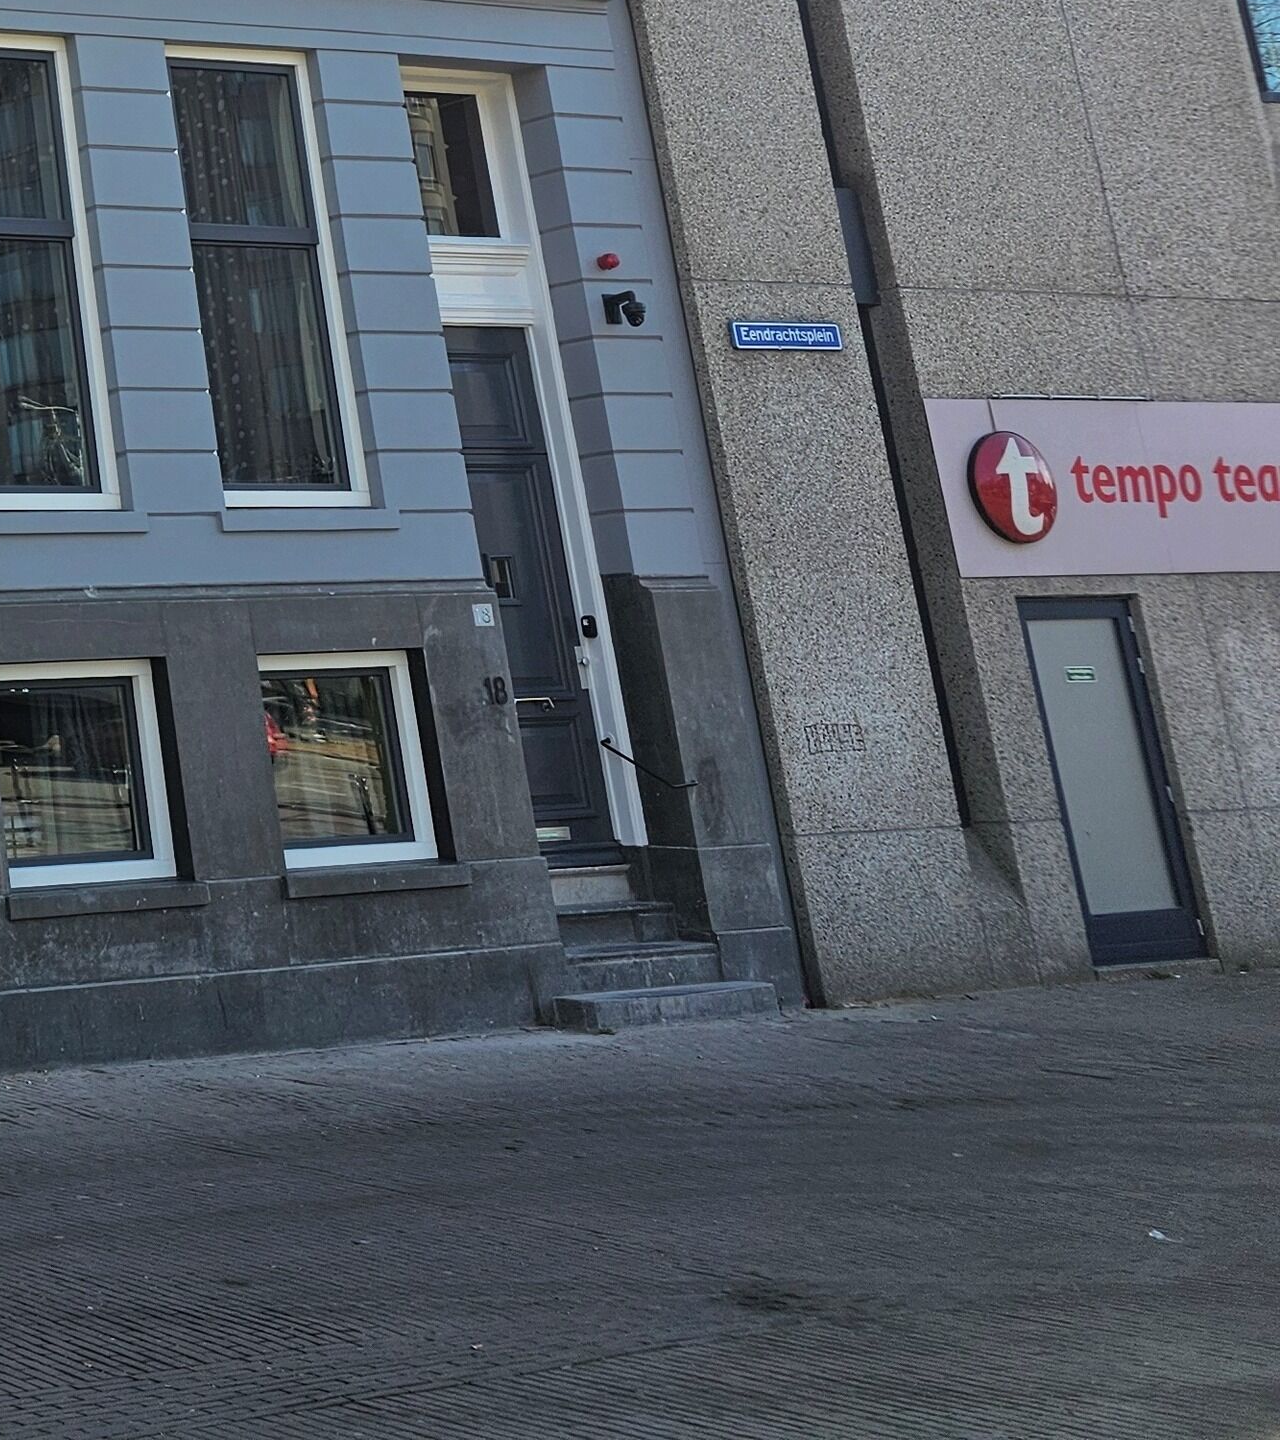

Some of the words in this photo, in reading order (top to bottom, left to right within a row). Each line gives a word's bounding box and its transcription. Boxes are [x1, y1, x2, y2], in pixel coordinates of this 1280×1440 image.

[740, 327, 835, 345] Eendrachtsplein
[1070, 456, 1202, 518] tempo
[483, 676, 508, 705] 18
